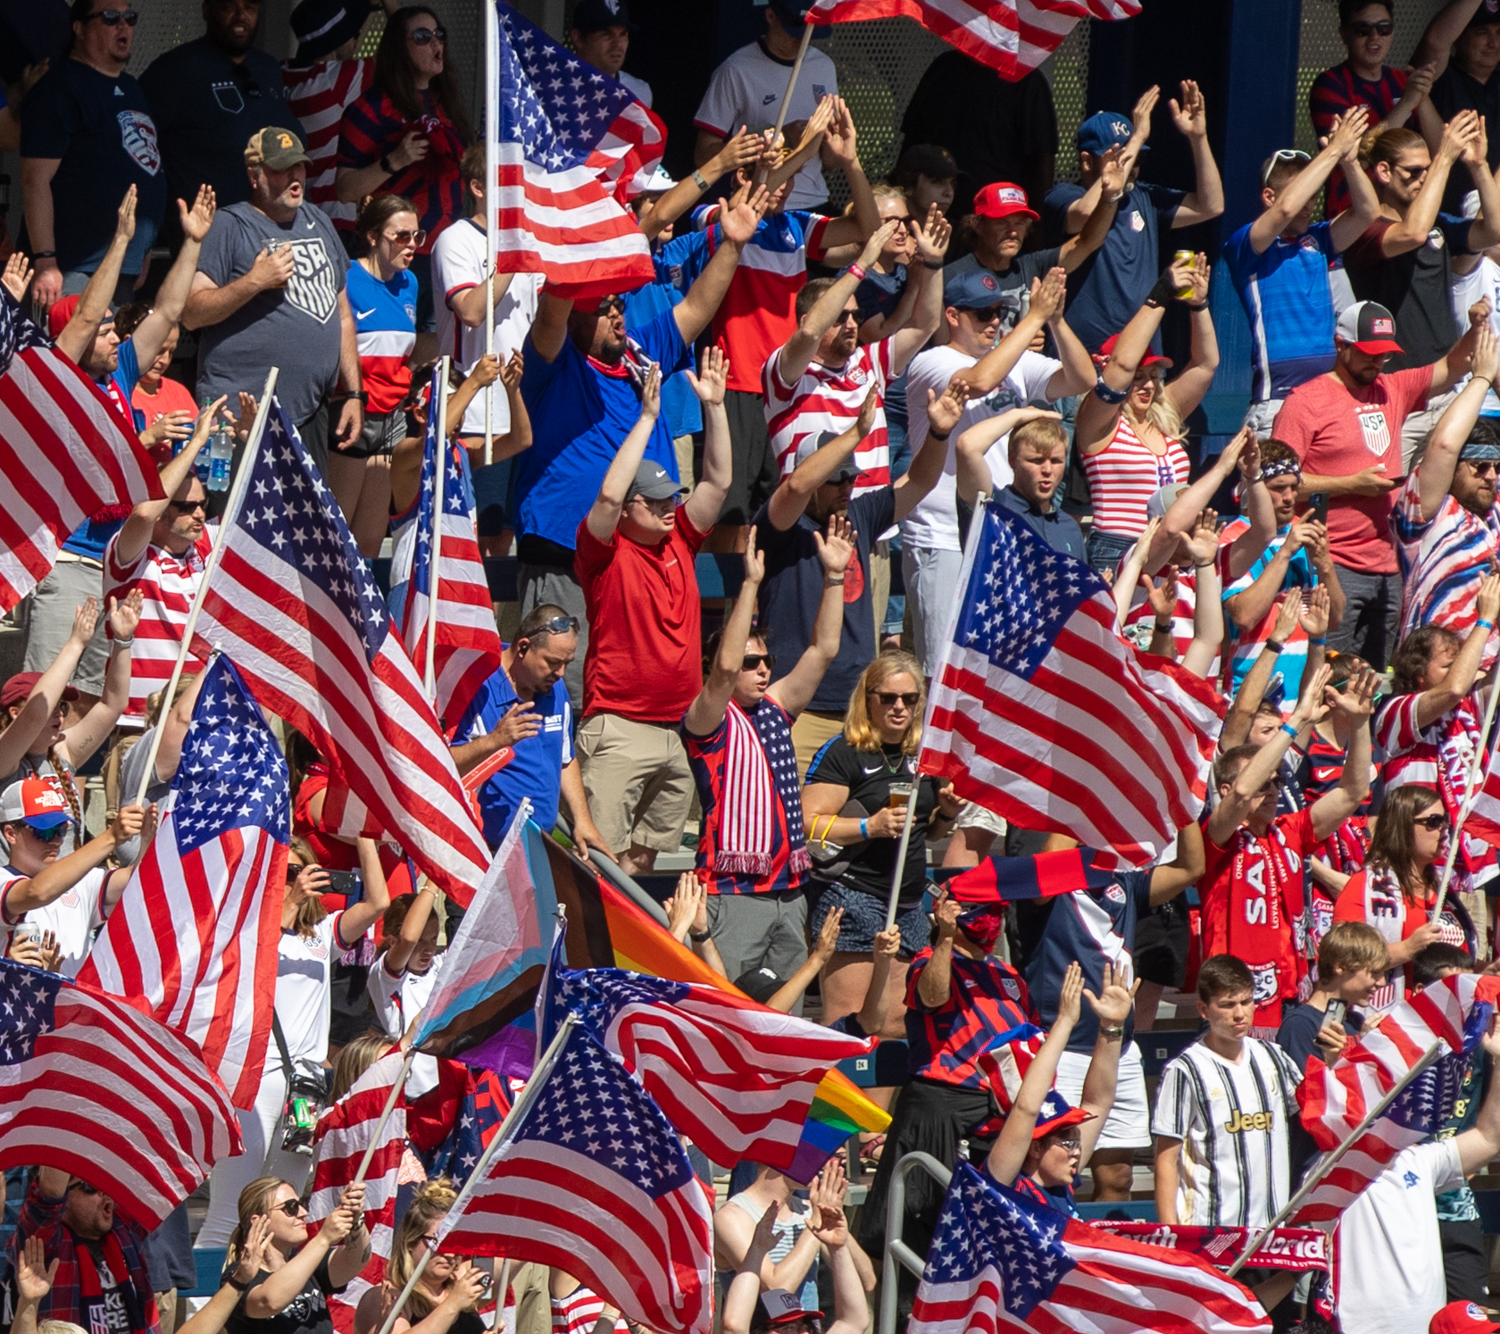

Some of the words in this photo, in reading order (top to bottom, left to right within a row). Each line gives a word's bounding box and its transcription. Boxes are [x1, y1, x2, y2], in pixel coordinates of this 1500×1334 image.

[1111, 121, 1131, 137] KC
[1361, 413, 1385, 431] USA
[1223, 1109, 1275, 1134] Jeep
